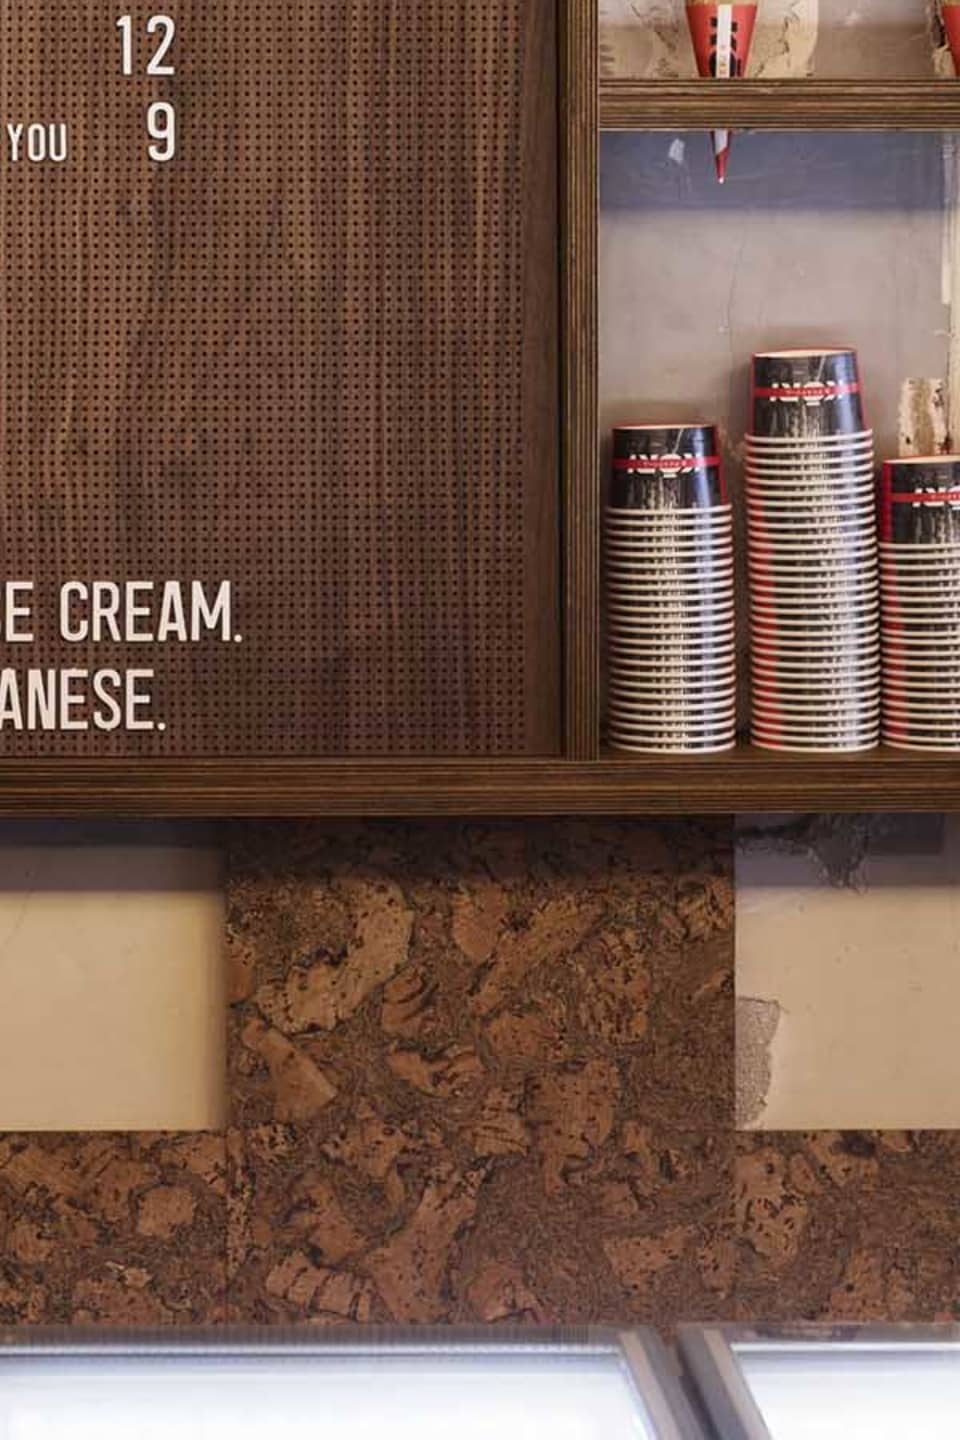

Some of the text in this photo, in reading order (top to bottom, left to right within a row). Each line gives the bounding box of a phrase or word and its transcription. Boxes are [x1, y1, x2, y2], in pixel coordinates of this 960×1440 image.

[116, 15, 175, 75] 12
[7, 123, 67, 162] YOU
[147, 101, 175, 161] 9
[60, 580, 242, 643] CREAM.
